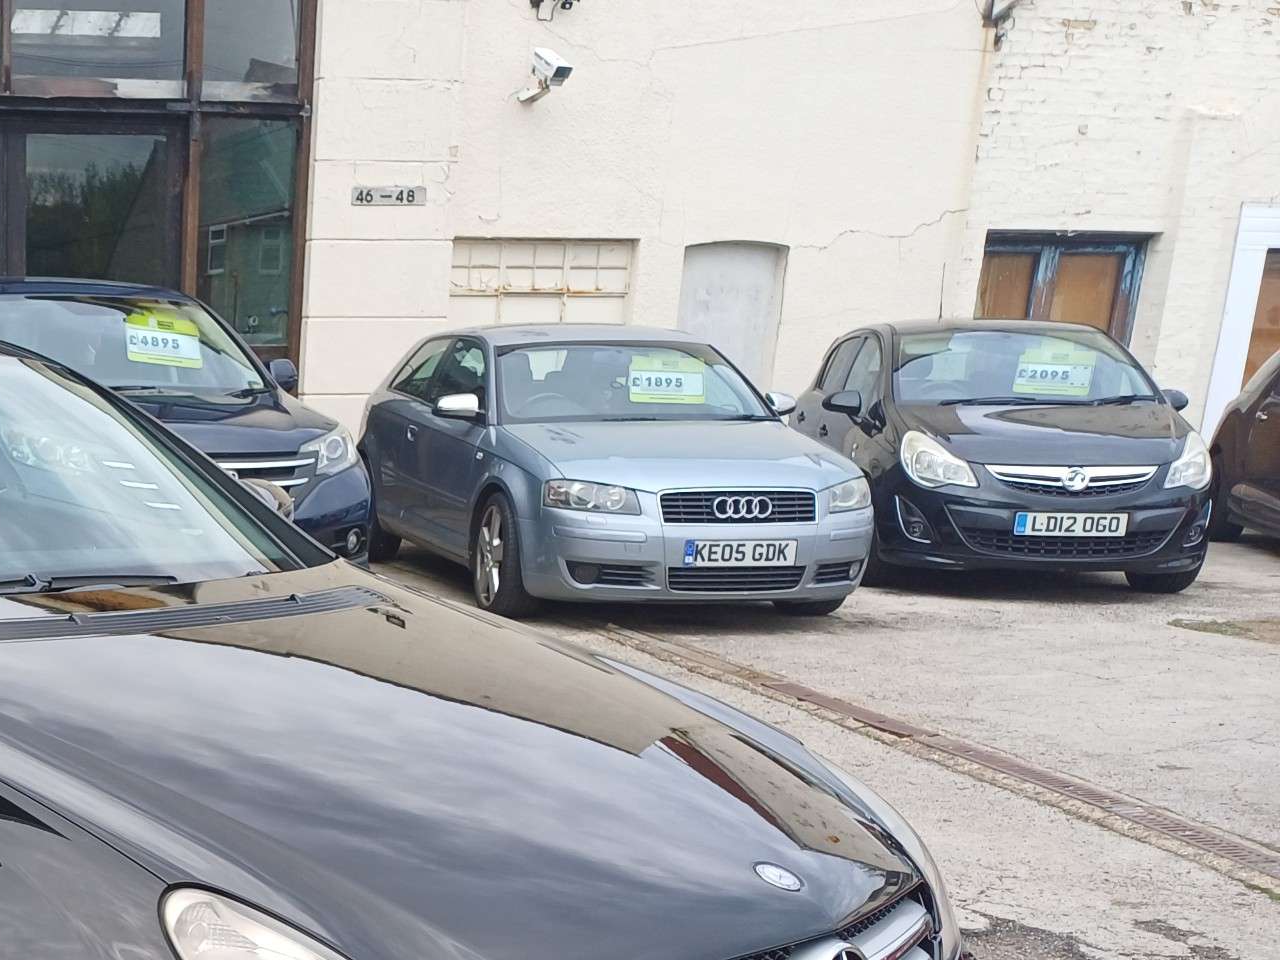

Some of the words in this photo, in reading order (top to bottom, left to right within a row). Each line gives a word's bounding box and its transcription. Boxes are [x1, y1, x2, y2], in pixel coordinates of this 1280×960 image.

[1031, 515, 1077, 533] LD12
[694, 543, 747, 562] KE05
[751, 543, 790, 562] GDK
